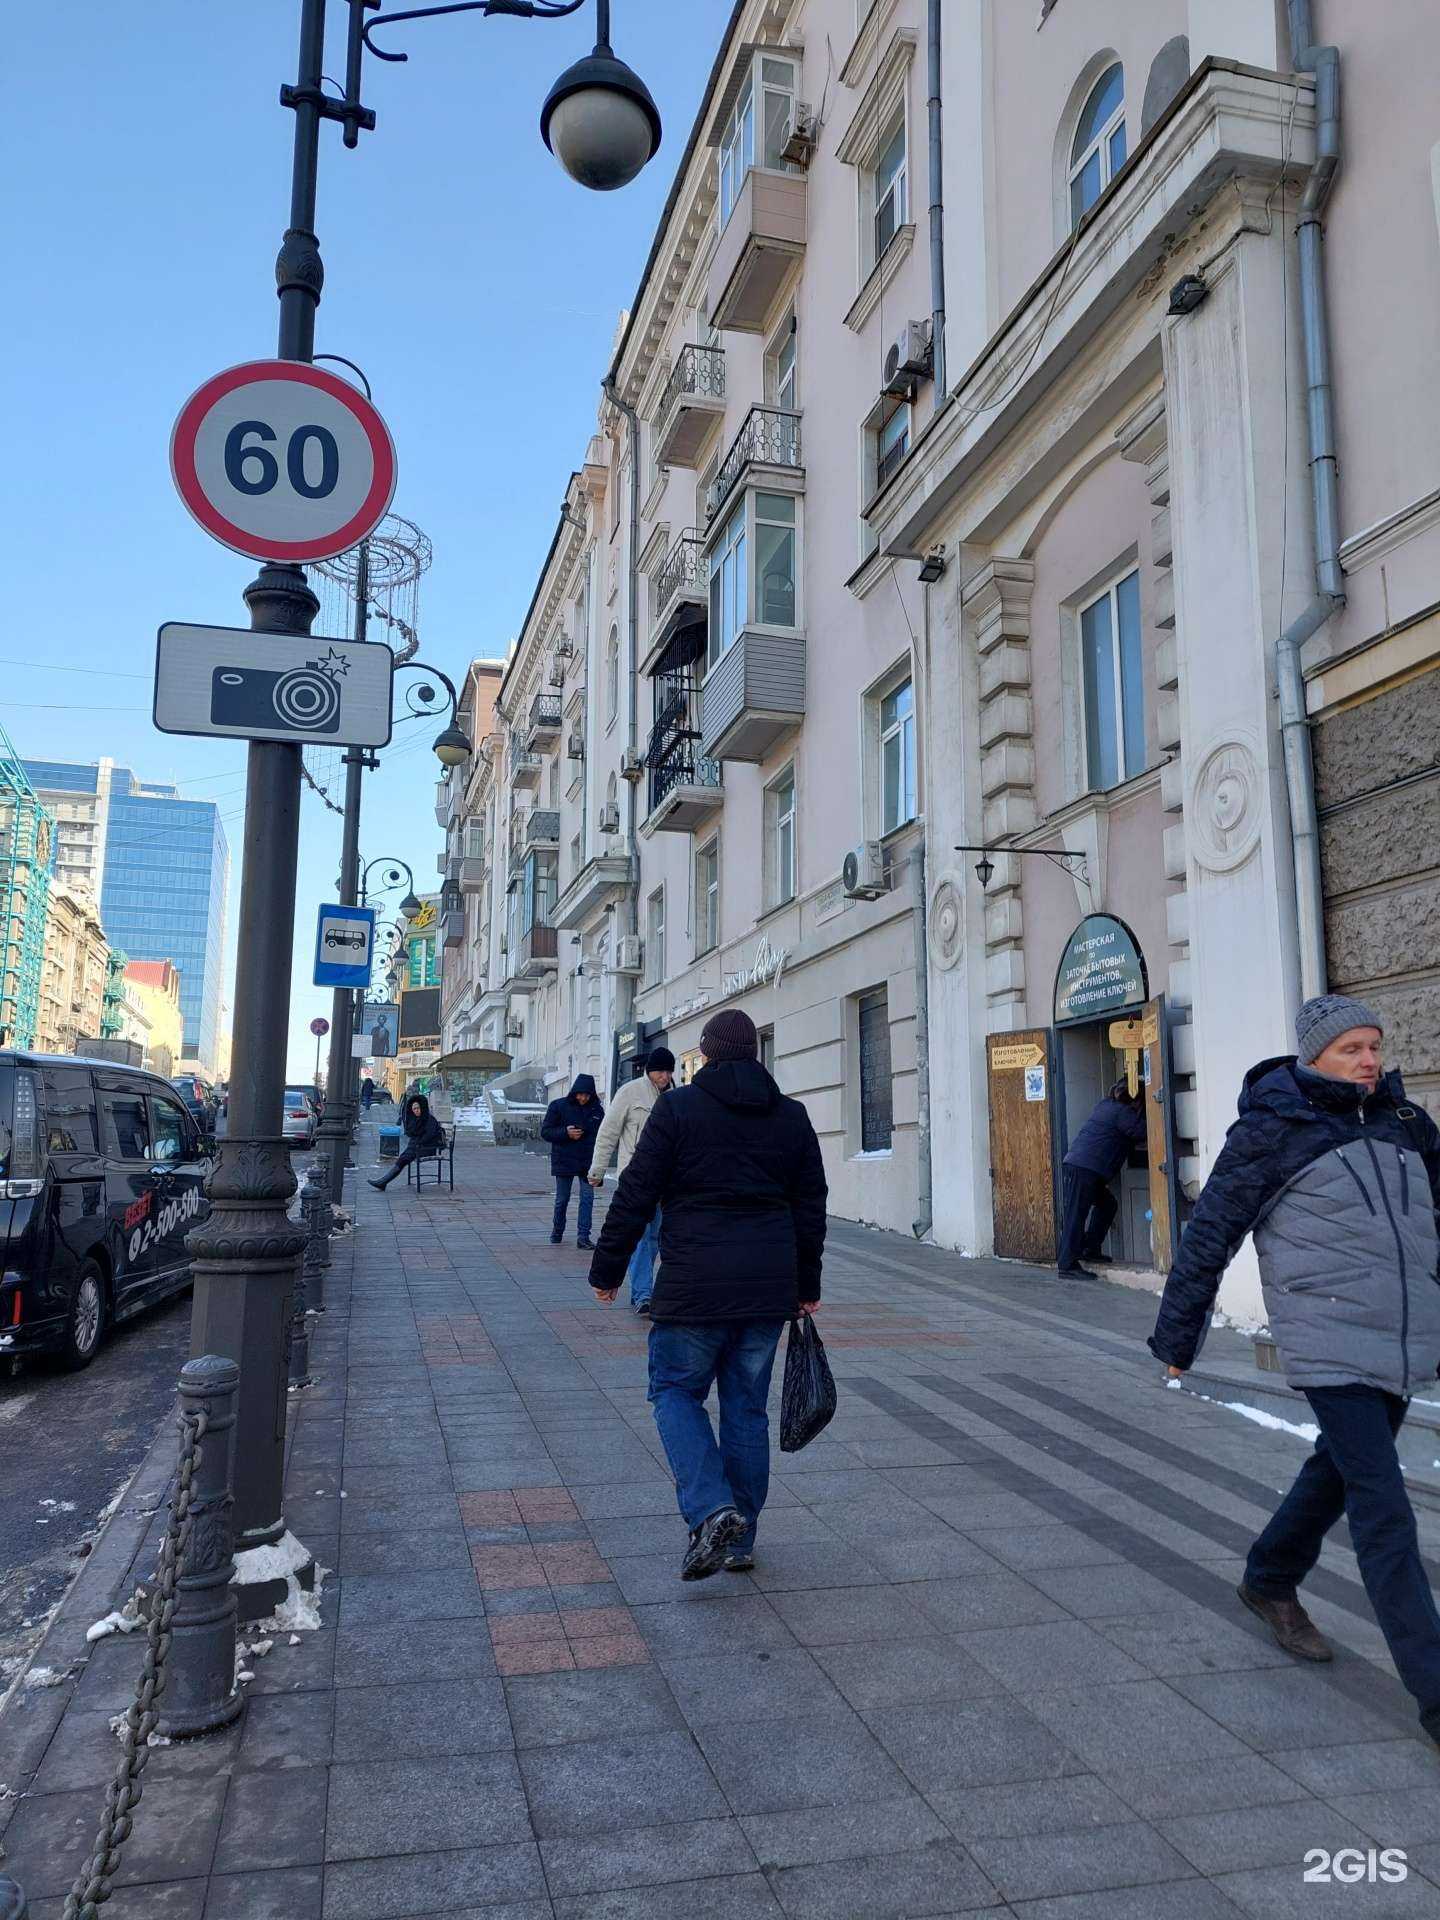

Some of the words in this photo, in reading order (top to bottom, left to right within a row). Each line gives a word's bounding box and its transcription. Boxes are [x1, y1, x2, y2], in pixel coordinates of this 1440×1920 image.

[224, 420, 339, 499] 60
[1073, 932, 1115, 954] МАСТЕРСКАЯ
[1066, 964, 1091, 980] ЗАТОЧКЕ
[1091, 953, 1126, 972] БЫТОВЫХ
[1070, 969, 1122, 993] ИНСТРУМЕНТОВ,
[1060, 987, 1107, 1009] ИЗГОТОВЛЕНИЕ
[1107, 978, 1137, 997] КЛЮЧЕЙ
[140, 1185, 199, 1254] 2-500-500
